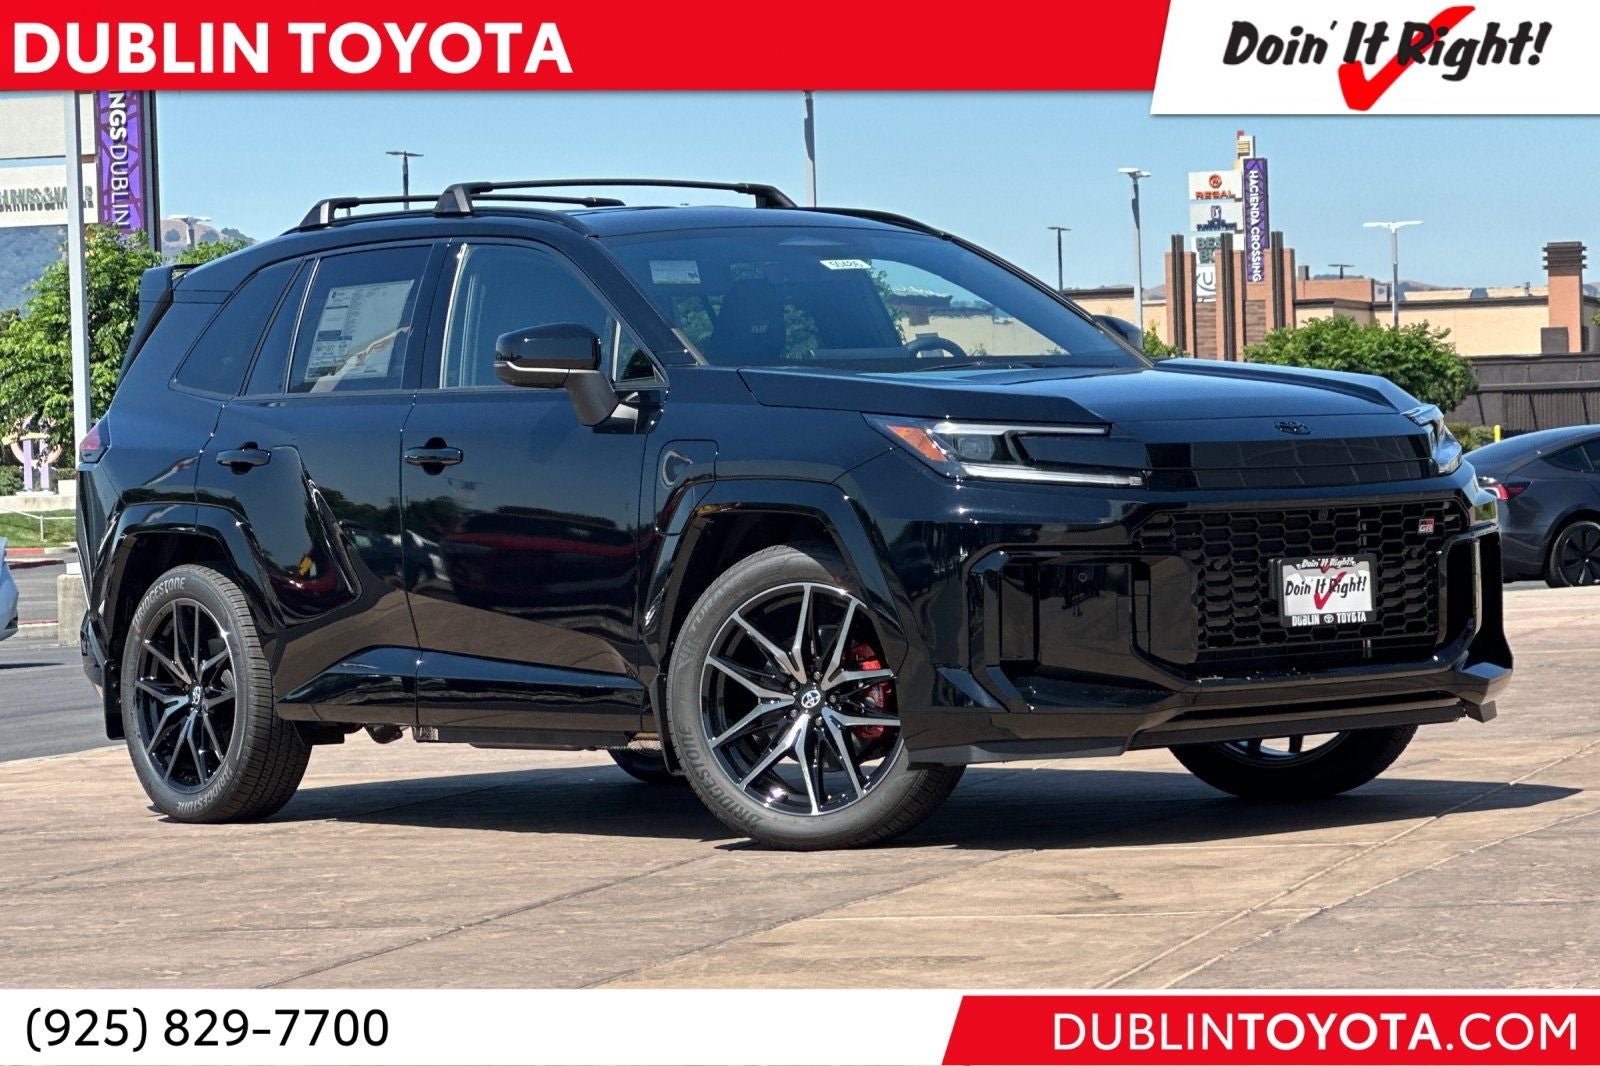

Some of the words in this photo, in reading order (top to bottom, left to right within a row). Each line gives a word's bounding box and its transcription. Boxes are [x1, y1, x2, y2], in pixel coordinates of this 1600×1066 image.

[110, 145, 130, 226] DUBLIN
[1249, 170, 1261, 226] HACIENDA
[1196, 236, 1221, 250] BES
[1250, 226, 1263, 283] CROSSING
[1285, 577, 1314, 596] Doin'
[1315, 578, 1327, 594] It
[1329, 575, 1367, 599] Right!
[1292, 613, 1320, 627] DUBLIN
[1336, 611, 1367, 625] TOYOTA
